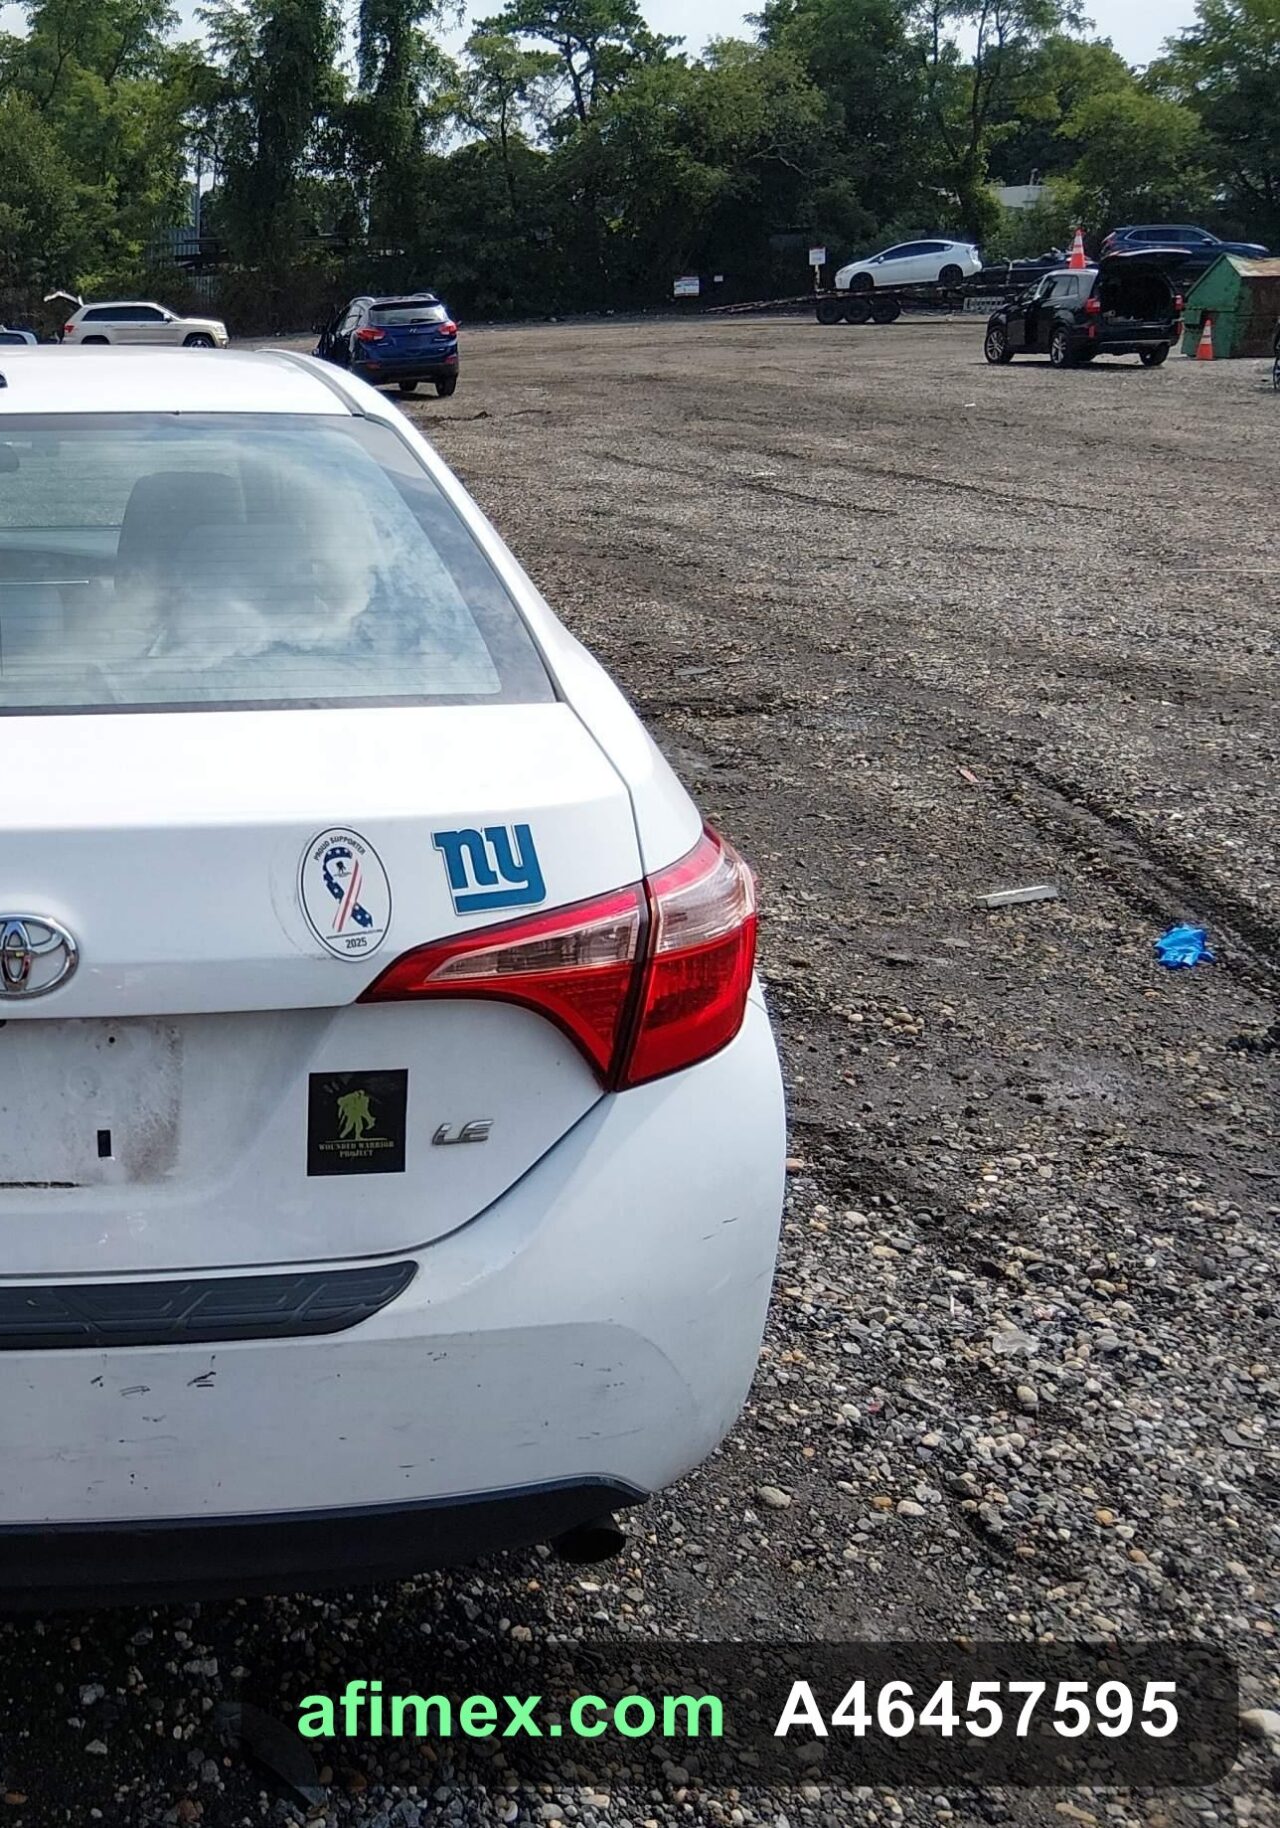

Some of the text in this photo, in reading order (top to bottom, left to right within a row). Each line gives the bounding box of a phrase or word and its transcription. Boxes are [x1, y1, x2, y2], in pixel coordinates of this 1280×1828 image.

[314, 835, 367, 861] PROUD SUPPORTER
[345, 937, 368, 949] 2025
[431, 1119, 494, 1146] LE
[318, 1140, 395, 1151] WOUNDED WARRIOR
[339, 1149, 374, 1158] PROJECT
